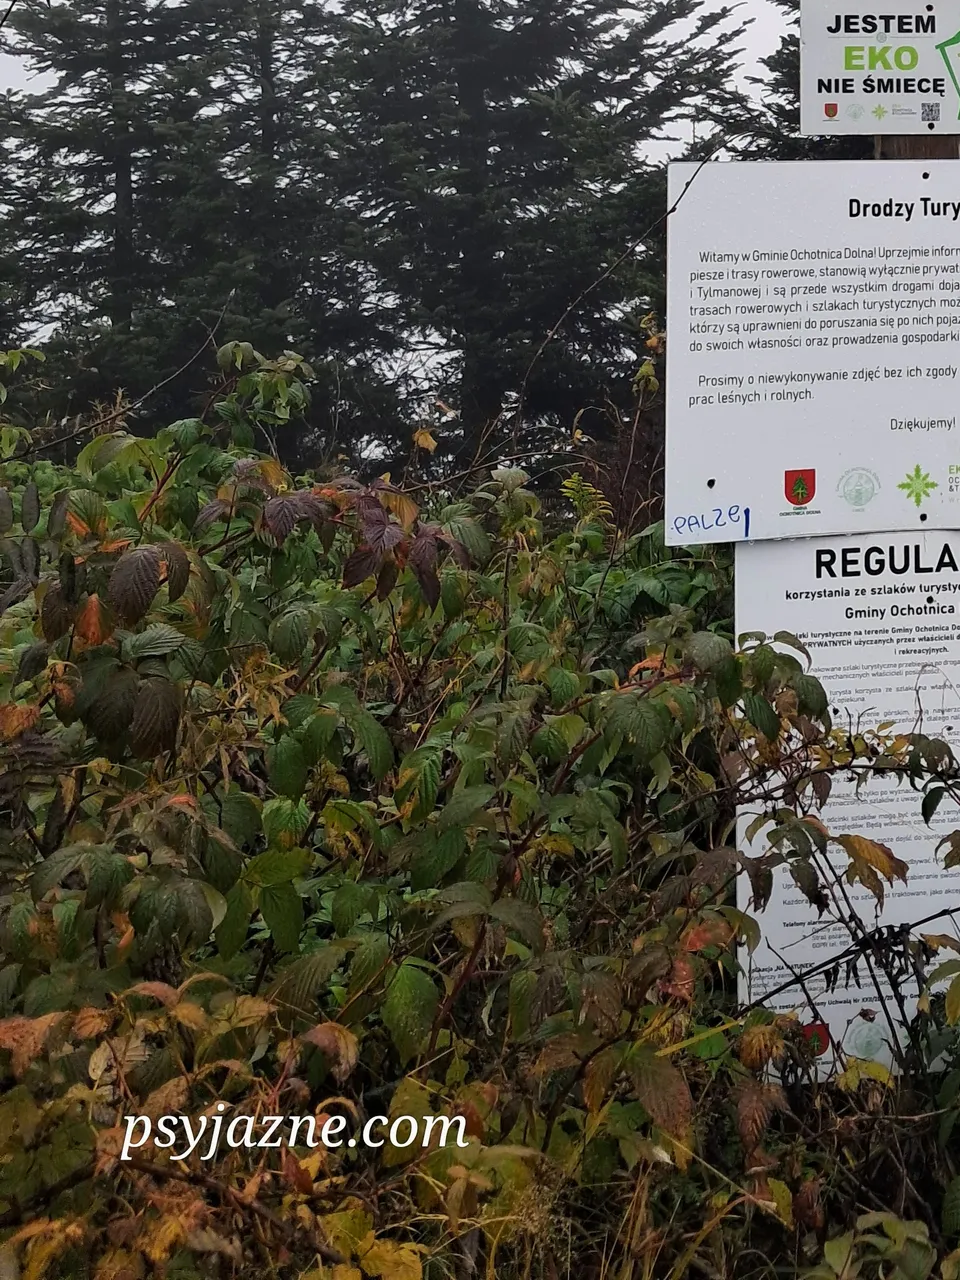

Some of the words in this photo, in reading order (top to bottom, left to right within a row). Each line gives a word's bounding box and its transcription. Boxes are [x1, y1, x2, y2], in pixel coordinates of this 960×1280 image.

[826, 14, 936, 34] JESTEM
[844, 45, 919, 71] EKO
[817, 78, 855, 94] NIE
[862, 74, 945, 97] ŚMIECĘ
[849, 198, 915, 222] Drodzy
[699, 251, 740, 265] Witamy
[741, 252, 751, 262] w
[752, 250, 789, 262] Gminie
[790, 249, 842, 261] Ochotnica
[844, 247, 877, 259] Dolna!
[878, 246, 930, 261] Uprzejmie
[689, 270, 724, 284] piesze
[731, 268, 760, 282] trasy
[761, 268, 818, 280] rowerowe,
[819, 265, 866, 278] stanowią
[868, 264, 921, 276] wyłącznie
[697, 285, 762, 300] Tylmanowej
[773, 287, 786, 298] są
[790, 284, 827, 296] przede
[831, 281, 888, 295] wszystkim
[891, 280, 934, 293] drogami
[689, 305, 731, 316] trasach
[735, 301, 802, 315] rowerowych
[812, 300, 859, 312] szlakach
[862, 297, 936, 311] turystycznych
[689, 321, 725, 335] którzy
[727, 324, 740, 334] są
[742, 320, 802, 334] uprawnieni
[804, 319, 817, 330] do
[820, 318, 877, 331] poruszania
[879, 317, 895, 329] się
[897, 318, 909, 328] po
[912, 314, 934, 326] nich
[689, 341, 702, 352] do
[706, 338, 744, 351] swoich
[747, 335, 802, 350] własności
[805, 336, 829, 347] oraz
[832, 333, 899, 348] prowadzenia
[901, 330, 960, 346] gospodarki
[698, 373, 744, 388] Prosimy
[747, 374, 755, 385] o
[758, 370, 848, 384] niewykonywanie
[852, 365, 881, 381] zdjęć
[884, 367, 903, 379] bez
[906, 366, 922, 378] ich
[926, 364, 958, 379] zgody
[688, 394, 714, 408] prac
[717, 391, 761, 405] leśnych
[890, 417, 956, 432] Dziękujemy!
[785, 587, 850, 601] korzystania
[854, 587, 867, 597] ze
[870, 583, 916, 596] szlaków
[845, 605, 887, 620] Gminy
[890, 602, 955, 617] Ochotnica
[802, 640, 852, 649] PRYWATNYCH
[896, 636, 916, 644] przez
[918, 633, 955, 642] właścicieli
[810, 631, 851, 639] turystyczne
[864, 628, 889, 636] terenie
[891, 626, 914, 635] Gminy
[915, 624, 949, 633] Ochotnica
